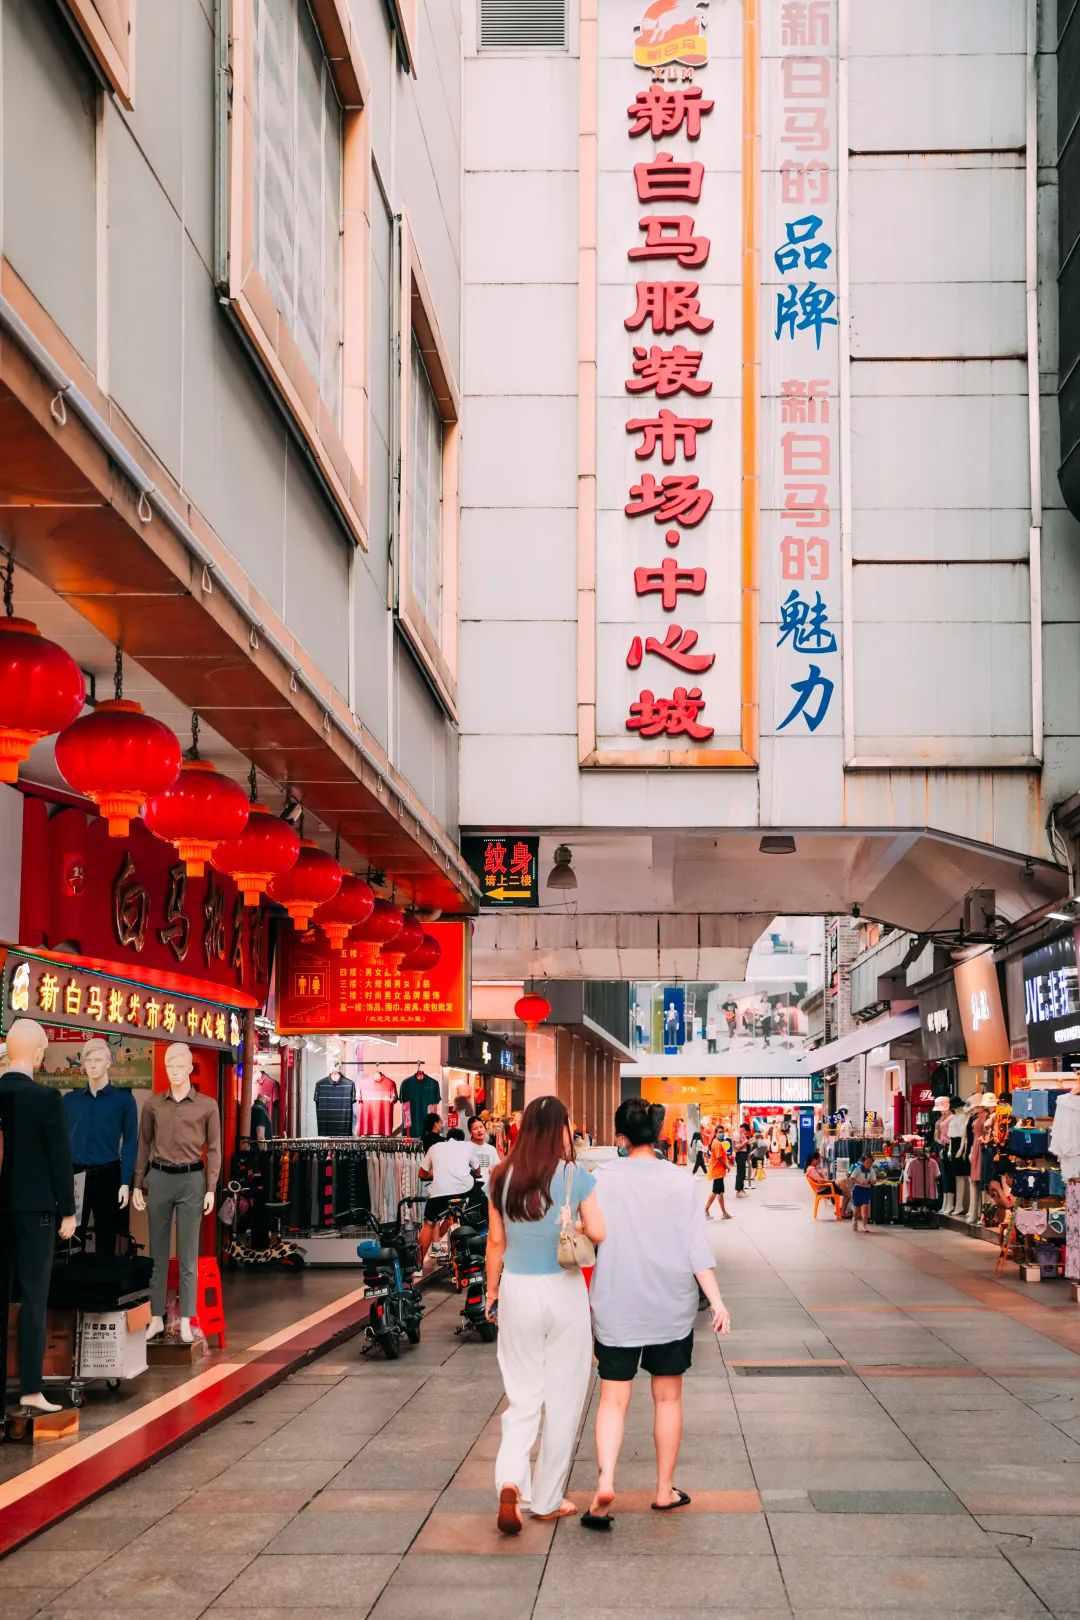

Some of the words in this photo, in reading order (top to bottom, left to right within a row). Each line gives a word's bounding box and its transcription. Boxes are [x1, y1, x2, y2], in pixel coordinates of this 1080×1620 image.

[624, 85, 715, 740] 新白马服装市场·中心城
[484, 842, 532, 875] 纹身
[485, 875, 532, 886] 请上二楼
